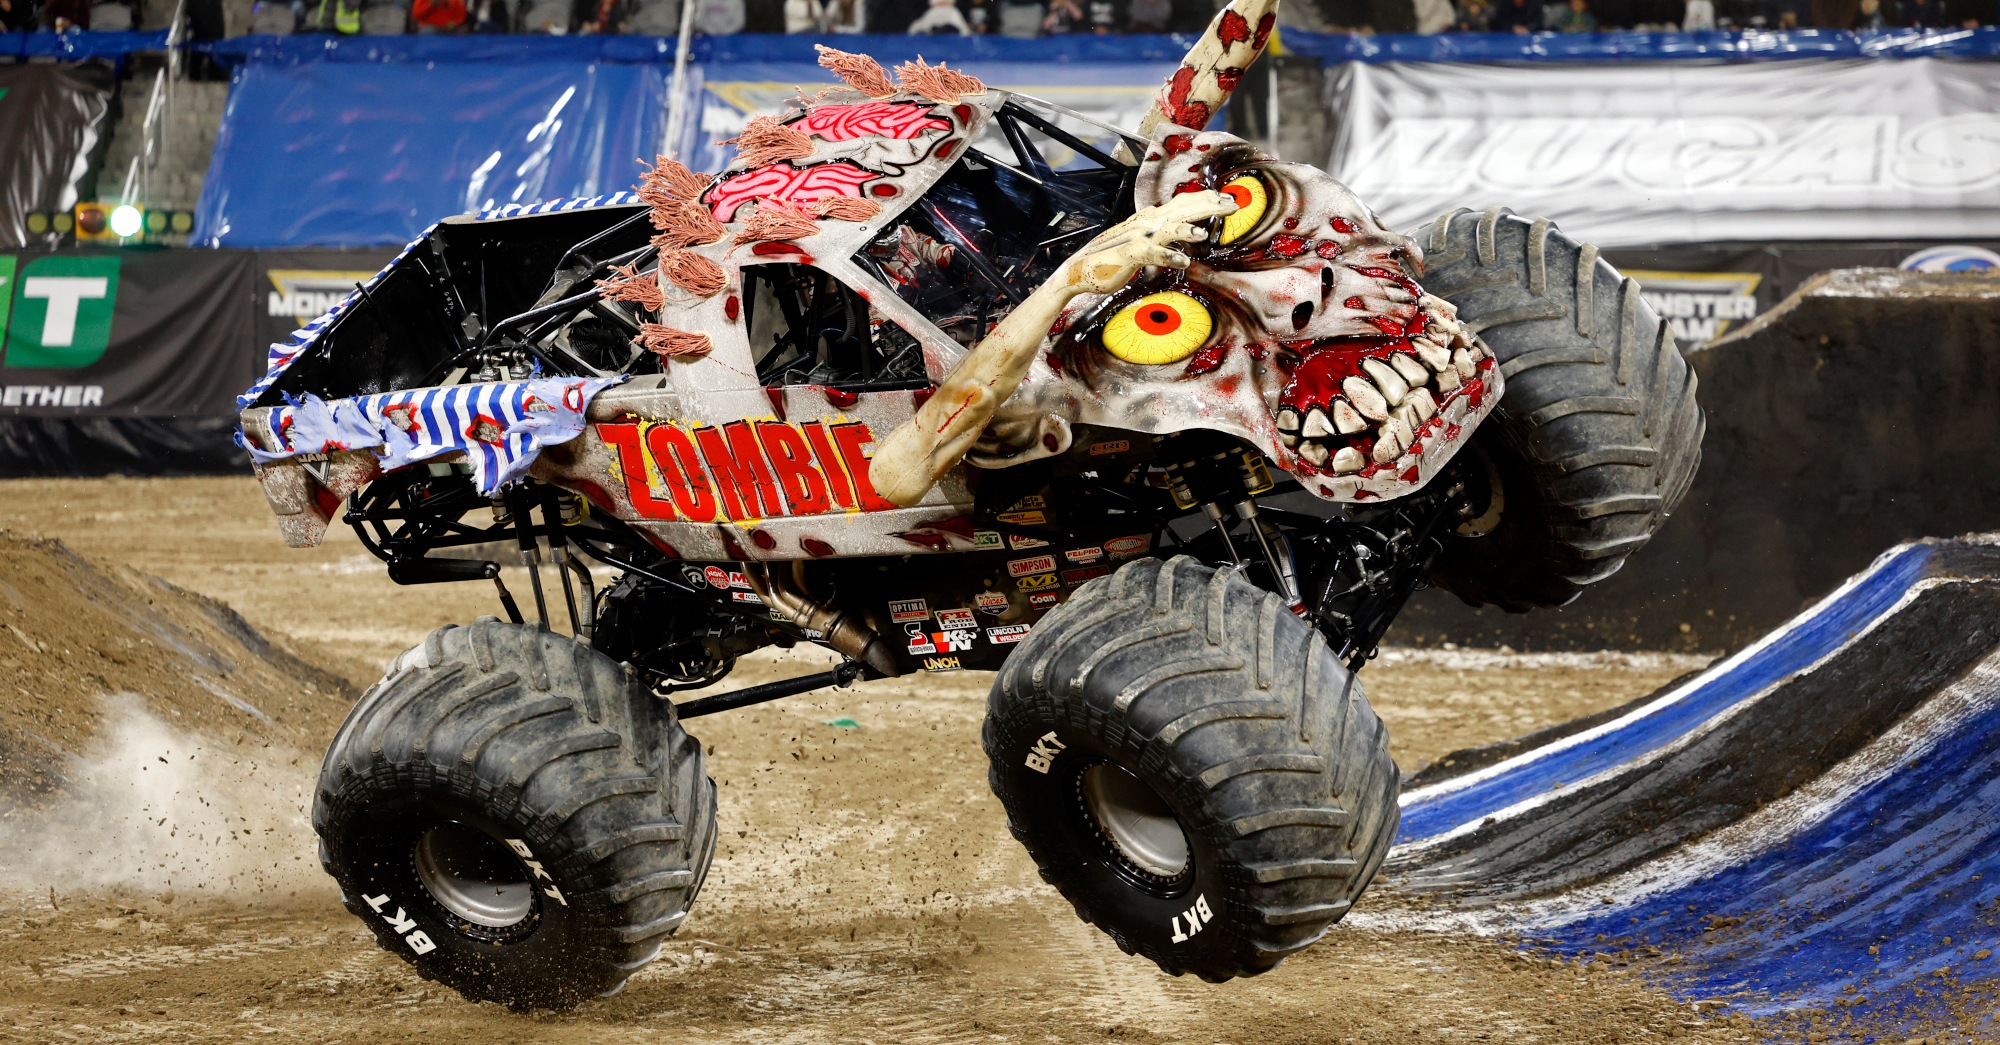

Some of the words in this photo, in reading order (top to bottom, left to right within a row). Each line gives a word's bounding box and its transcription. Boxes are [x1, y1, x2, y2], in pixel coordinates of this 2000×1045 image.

[1347, 113, 2000, 194] LUCAS
[0, 384, 104, 407] ETHER
[1091, 441, 1128, 452] CRD
[299, 452, 329, 463] JAM
[594, 418, 904, 522] ZOMBIE
[1012, 558, 1052, 574] SIMPSON
[706, 570, 725, 578] NGK
[982, 597, 1004, 606] LUCAS
[1029, 594, 1057, 604] Coan
[892, 601, 924, 613] OPTIMA
[949, 617, 973, 625] ROD
[989, 625, 1024, 636] LINCOLN
[924, 656, 961, 669] UNOH
[1024, 731, 1067, 775] BKT
[505, 838, 568, 906] BKT
[361, 893, 437, 956] BKT
[1171, 892, 1214, 944] BKT
